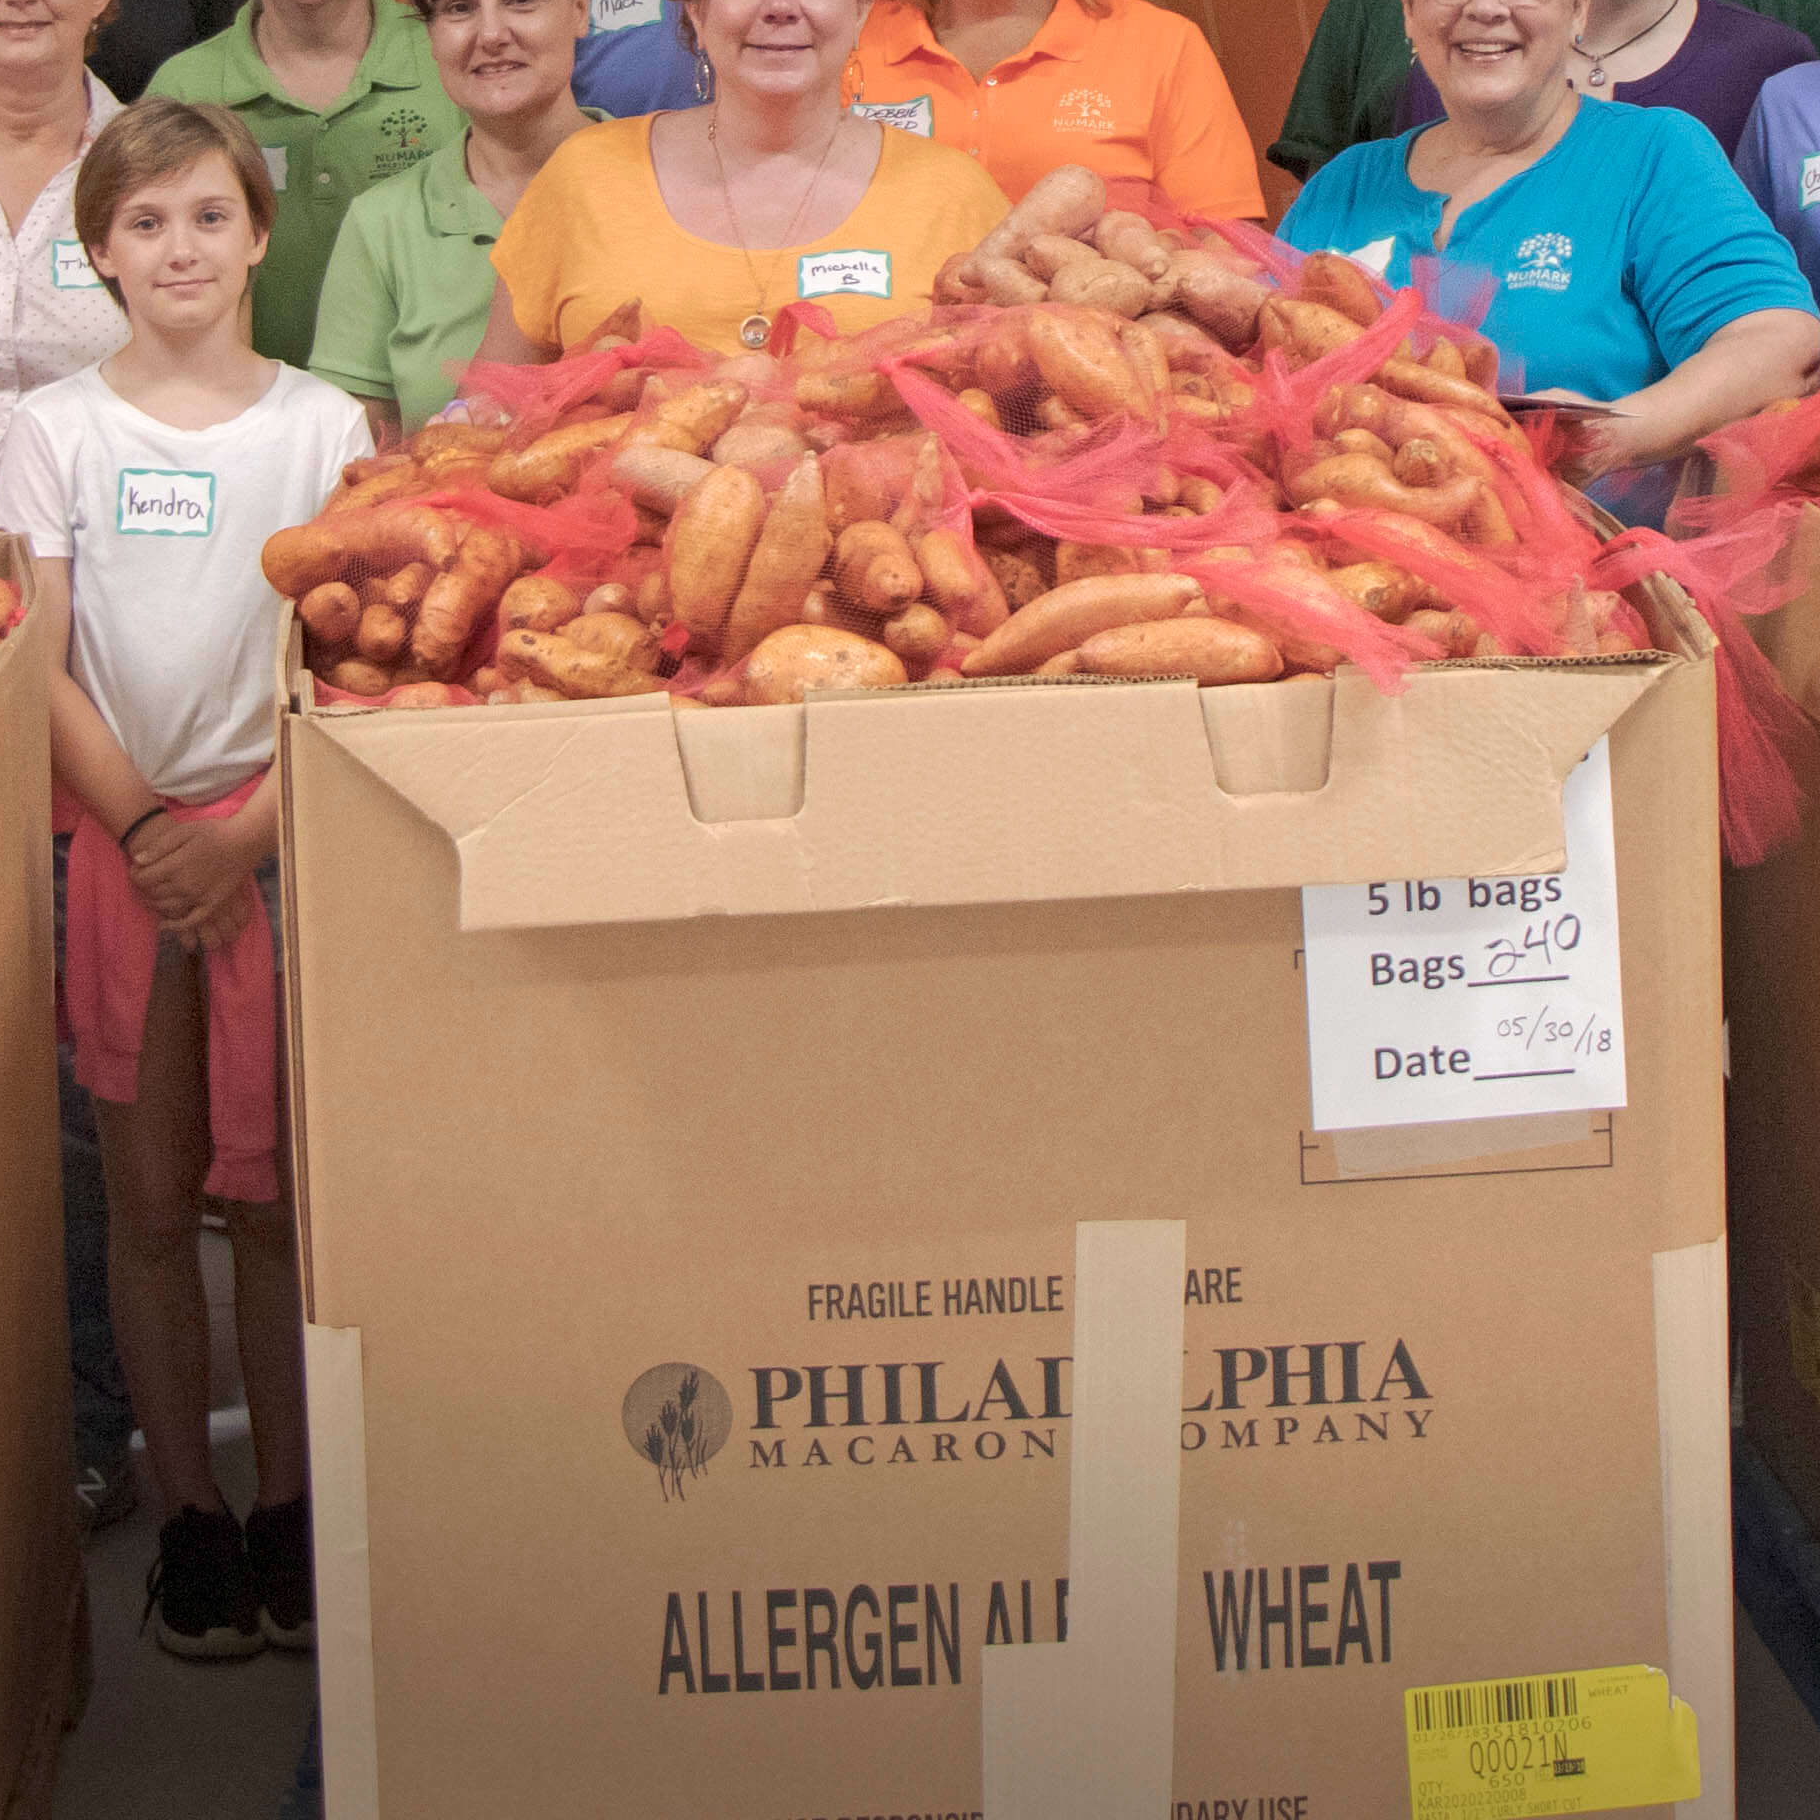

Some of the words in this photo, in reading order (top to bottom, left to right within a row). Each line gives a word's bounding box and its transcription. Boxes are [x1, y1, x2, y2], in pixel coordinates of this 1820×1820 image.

[861, 101, 924, 119] DEBBIE
[1053, 116, 1116, 131] NUMARK
[60, 259, 93, 272] Th
[841, 273, 861, 285] B
[1506, 268, 1572, 284] NUMARK
[128, 486, 205, 520] Kendra
[1369, 882, 1390, 916] 5
[1404, 880, 1442, 913] lb
[1468, 875, 1563, 913] bags
[1370, 952, 1466, 990] Bags
[1484, 913, 1581, 978] 240
[1374, 1045, 1472, 1081] Date
[1496, 1006, 1612, 1056] 05/30/18
[807, 1280, 933, 1322] FRAGILE
[942, 1275, 1064, 1317] HANDLE
[1182, 1266, 1244, 1307] ARE
[749, 1427, 1057, 1469] MACARON
[1180, 1408, 1435, 1451] OMPANY
[657, 1582, 962, 1696] ALLERGEN
[1203, 1560, 1401, 1673] WHEAT
[1588, 1684, 1629, 1698] WHEAT
[1469, 1732, 1569, 1780] Q0021N
[1417, 1781, 1444, 1795] QTY
[1489, 1773, 1525, 1789] 650
